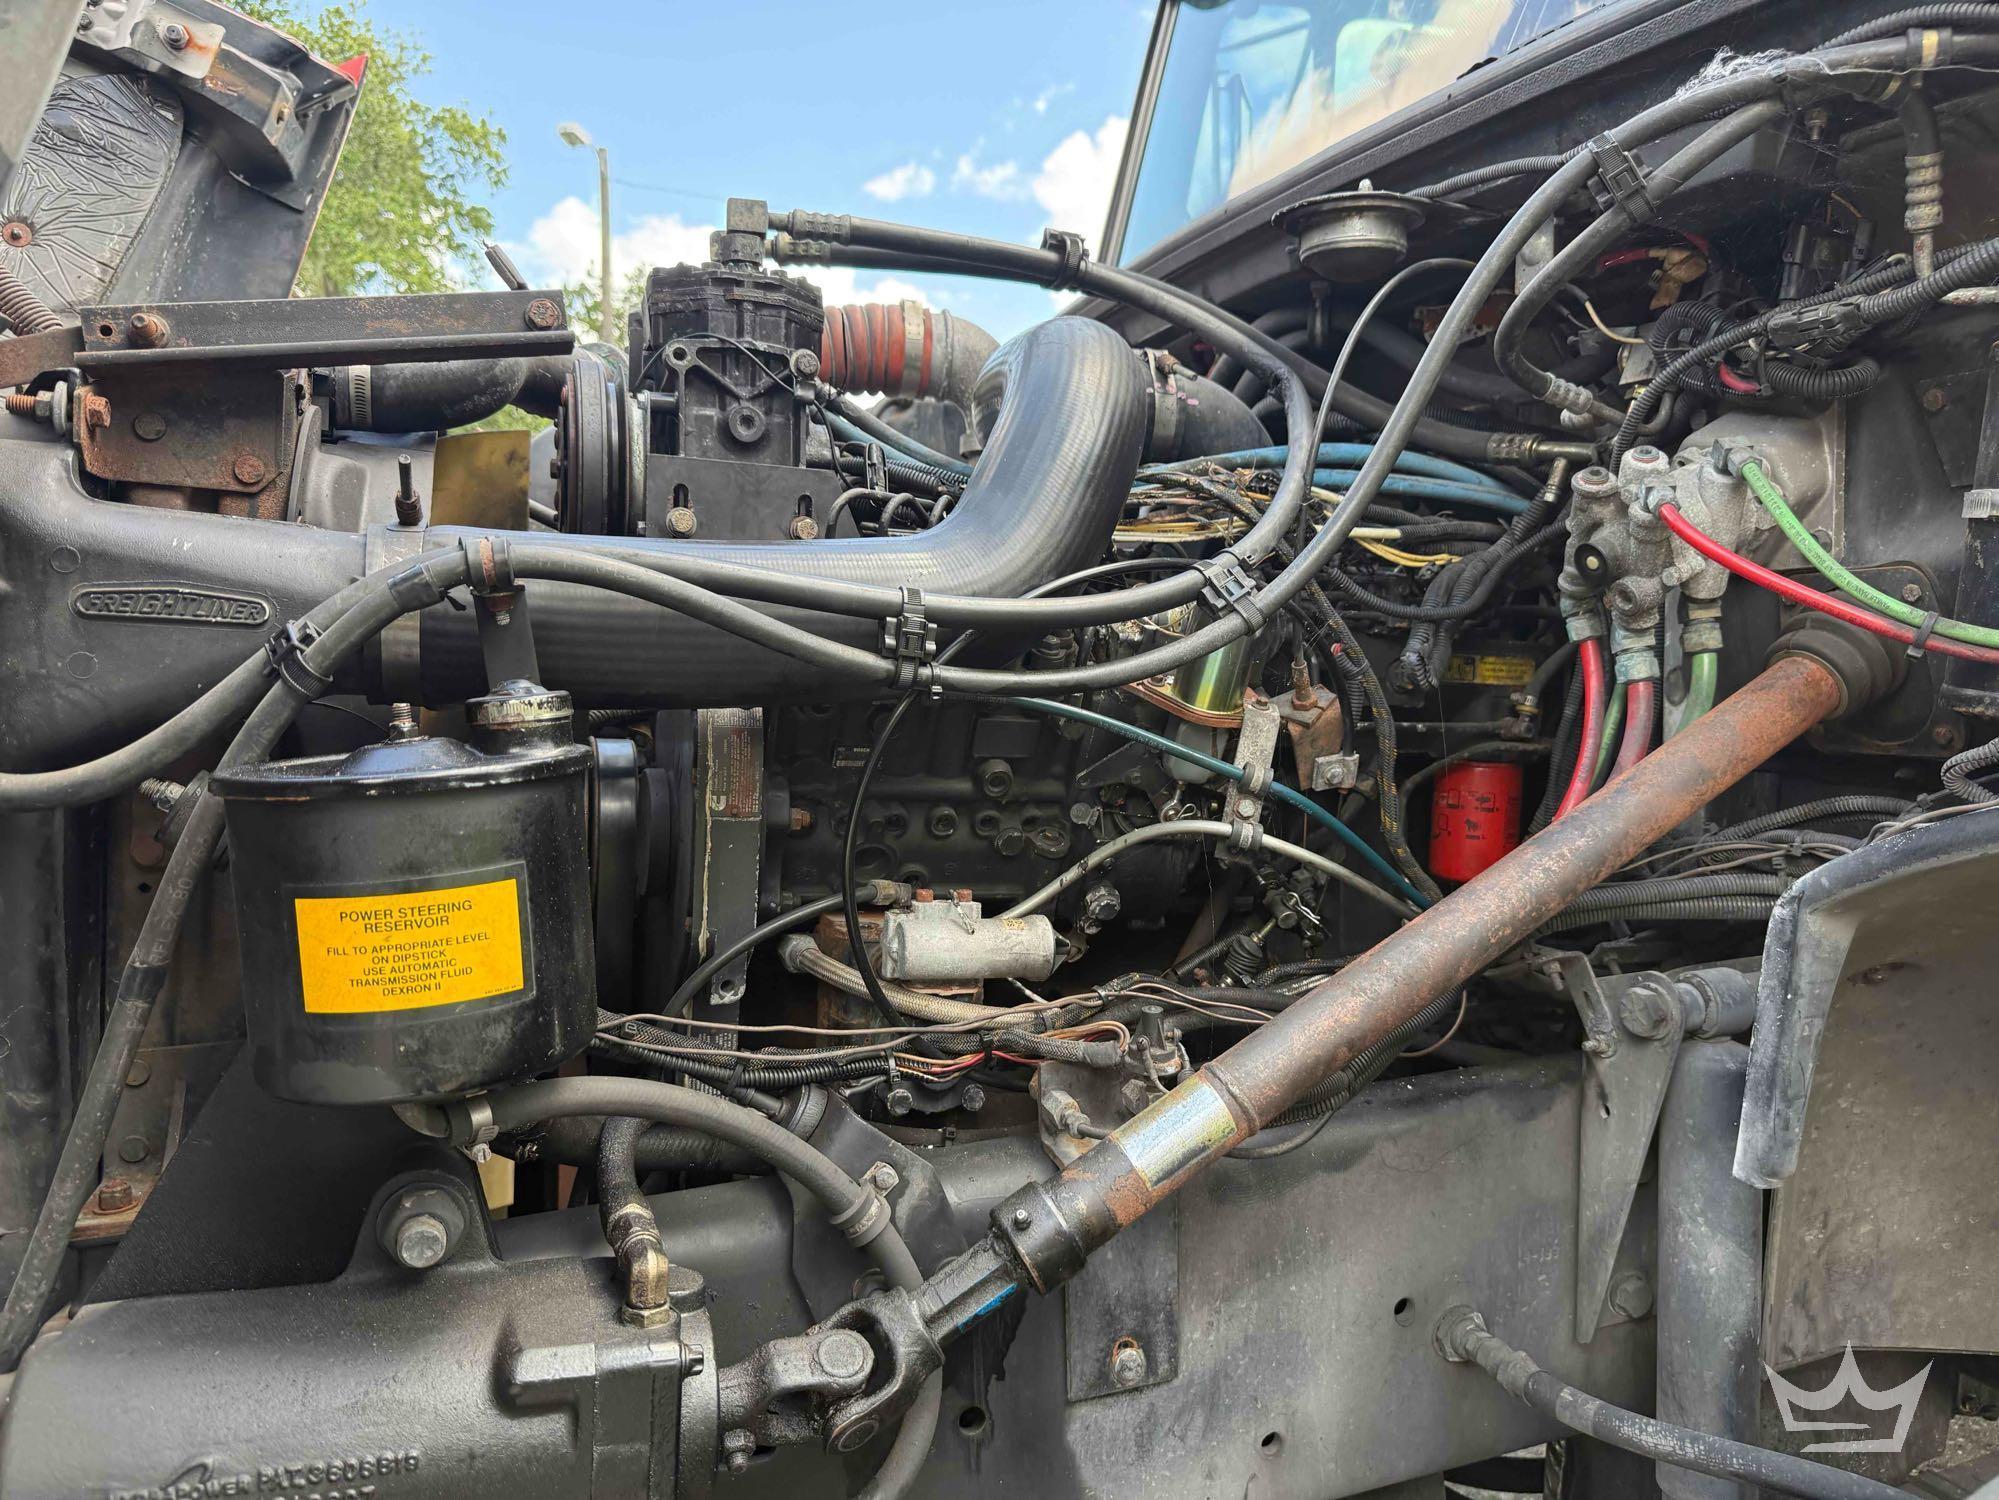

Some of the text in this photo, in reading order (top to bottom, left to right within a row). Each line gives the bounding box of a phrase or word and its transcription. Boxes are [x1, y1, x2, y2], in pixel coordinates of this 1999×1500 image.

[89, 593, 262, 621] FREIGHTLINER
[339, 900, 473, 923] POWER STEERING
[364, 915, 450, 934] RESERVOIR
[326, 931, 491, 956] FILL TO APPROPRIATE LEVEL
[363, 958, 457, 976] USE AUTOMATIC
[371, 949, 447, 965] ON DIPSTICK
[349, 966, 473, 988] TRANSMISSION FLUID
[382, 983, 441, 997] DEXRON II
